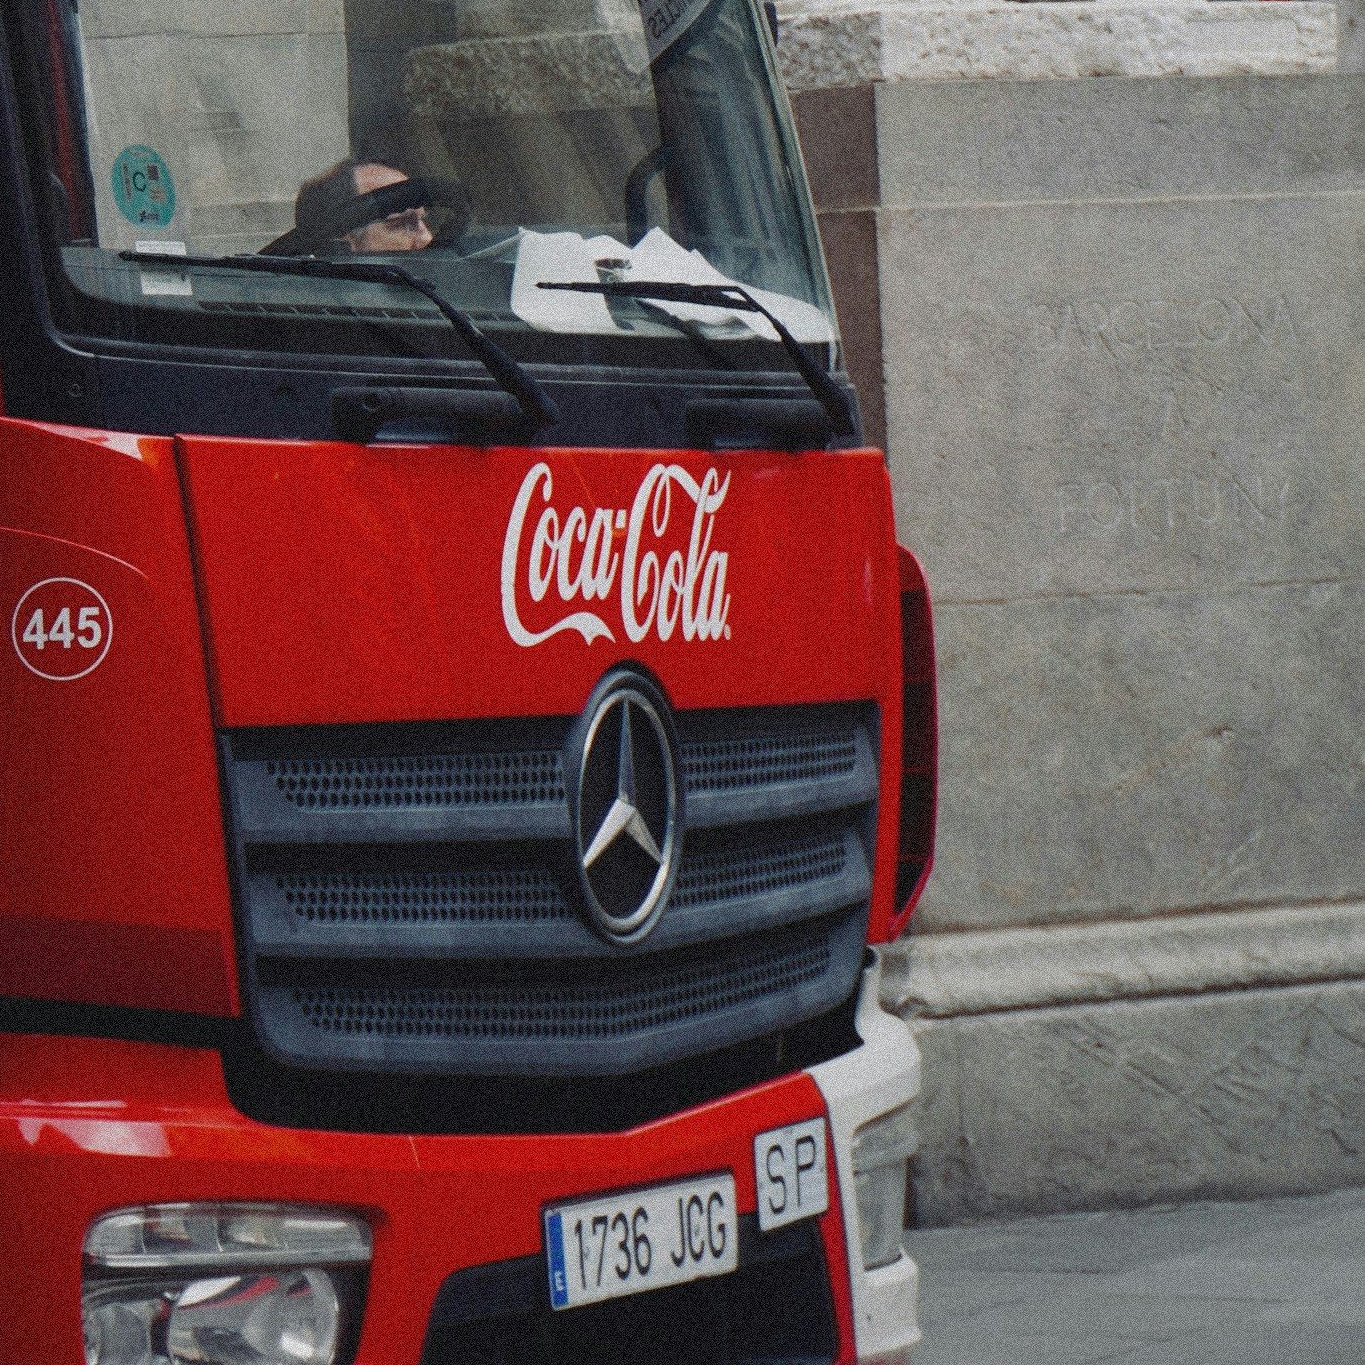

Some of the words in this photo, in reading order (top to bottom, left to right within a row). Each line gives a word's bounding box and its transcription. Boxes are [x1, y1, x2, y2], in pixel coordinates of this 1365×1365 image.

[501, 462, 731, 647] Coca-Cola
[22, 606, 102, 650] 445
[766, 1134, 817, 1215] SP
[573, 1206, 653, 1291] 1736
[670, 1190, 727, 1268] JCG
